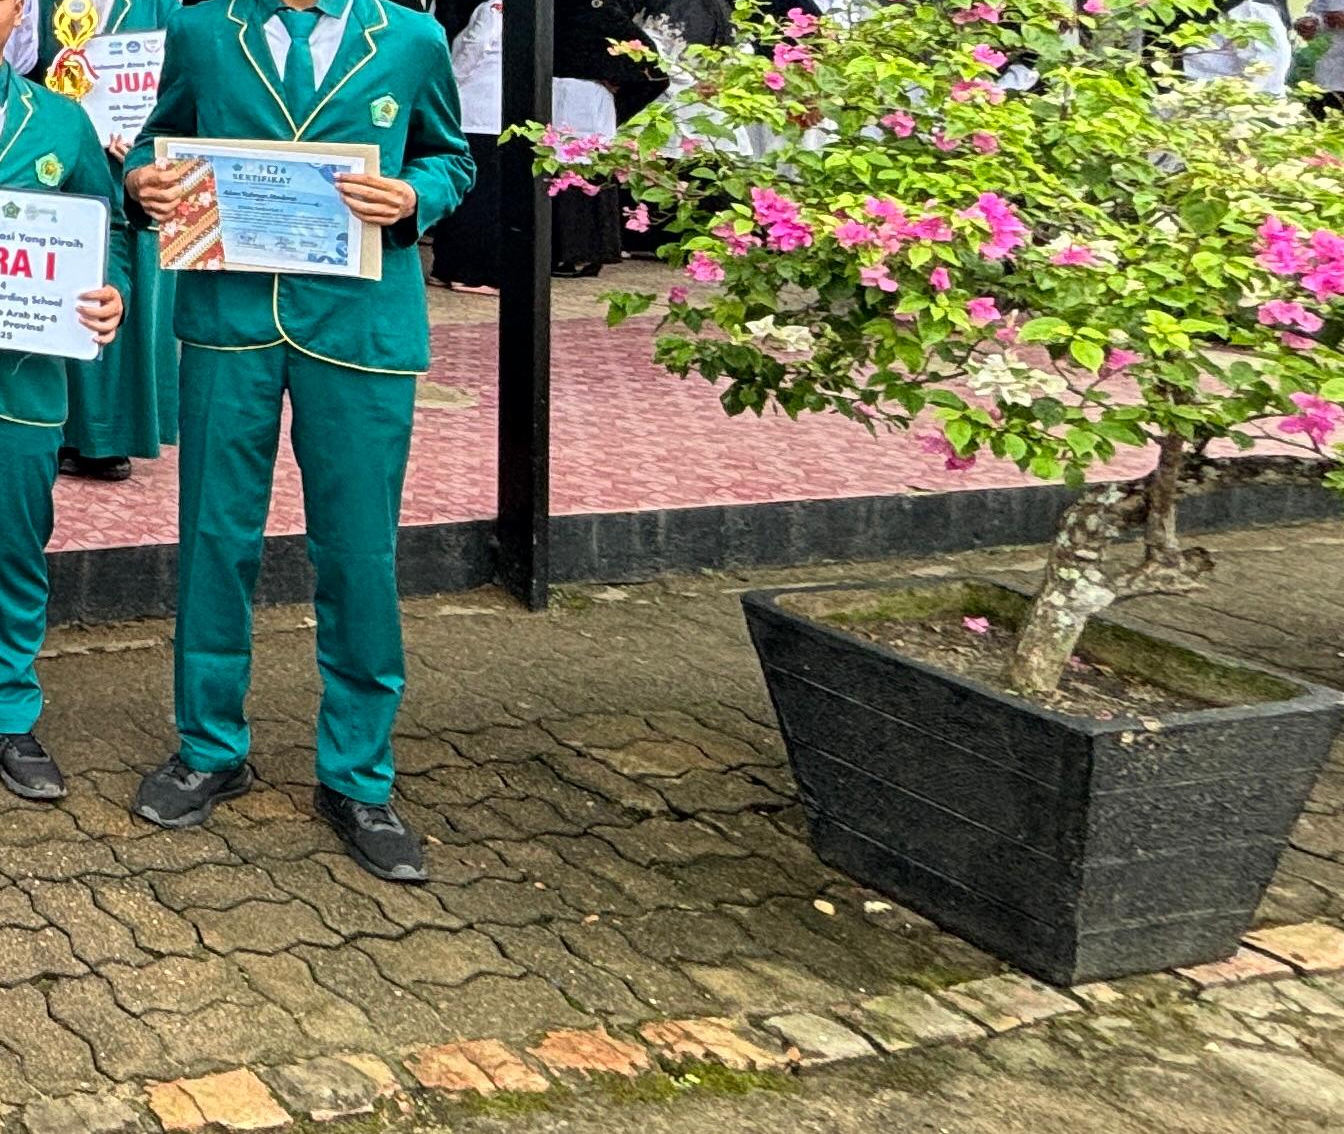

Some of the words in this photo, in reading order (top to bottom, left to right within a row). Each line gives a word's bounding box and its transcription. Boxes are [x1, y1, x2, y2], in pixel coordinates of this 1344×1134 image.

[108, 71, 158, 94] JUA
[18, 233, 46, 247] Yang
[49, 236, 84, 249] Diraih
[45, 252, 56, 281] I
[31, 295, 63, 308] School
[6, 309, 31, 321] Arab
[2, 320, 45, 333] Provinsi
